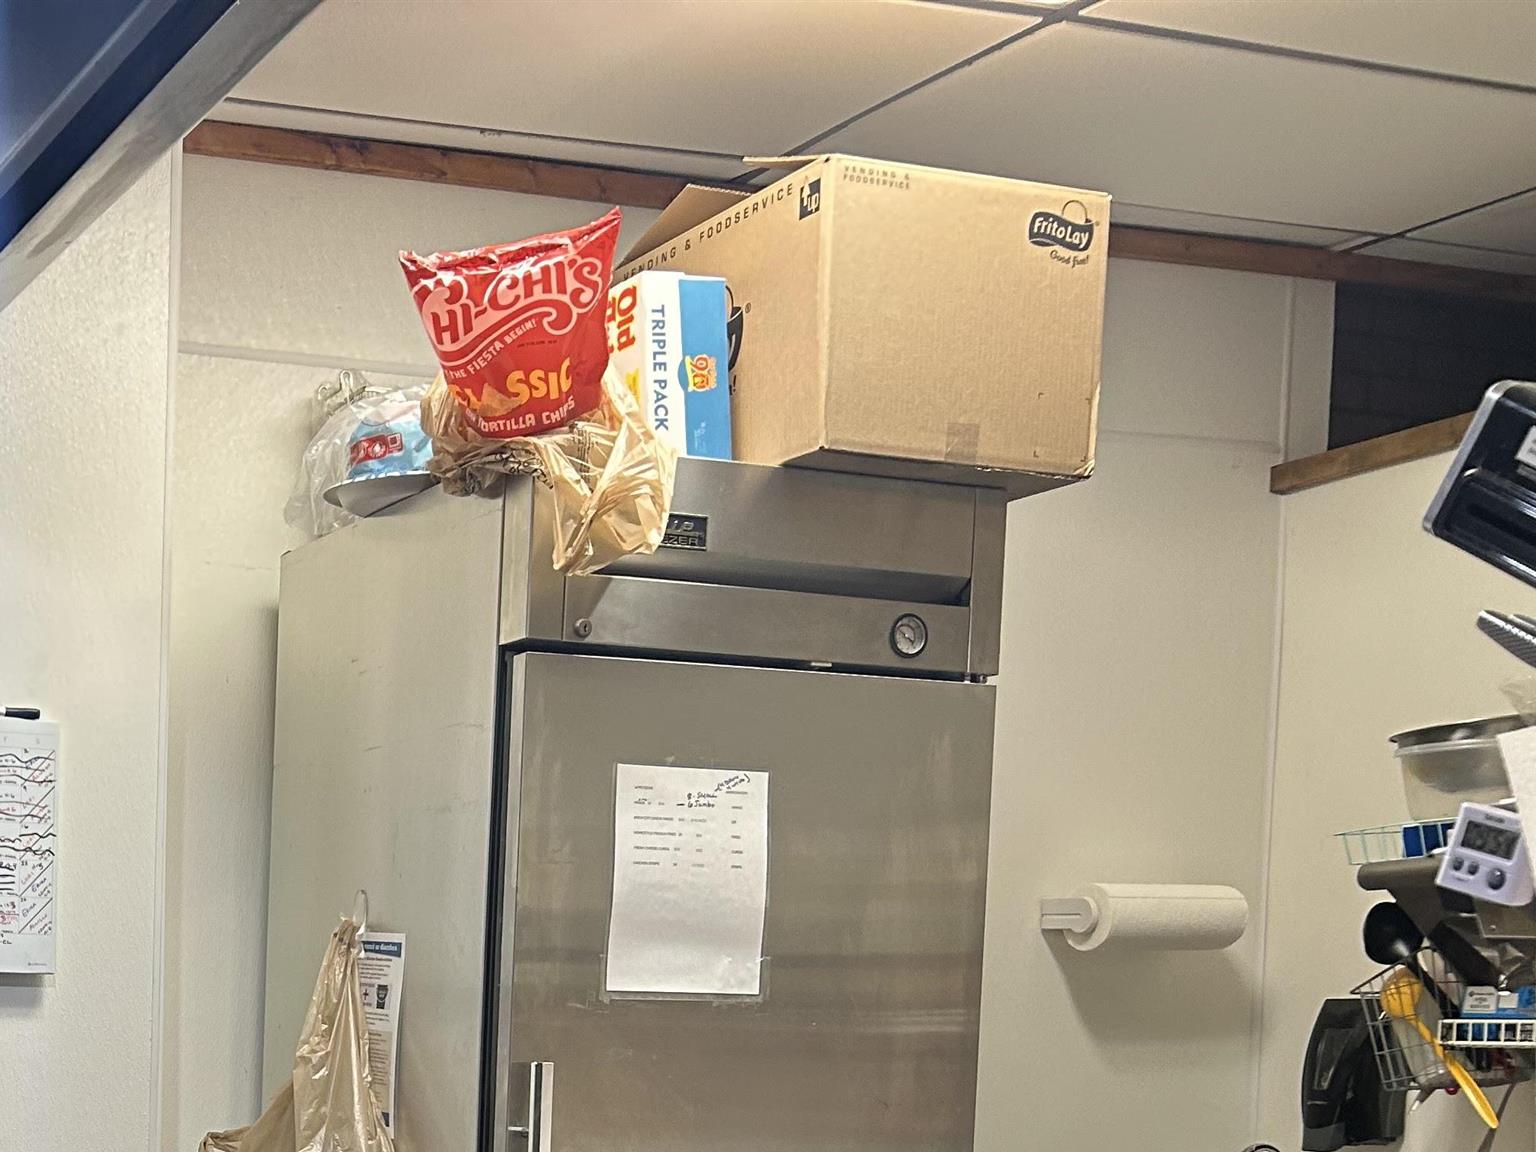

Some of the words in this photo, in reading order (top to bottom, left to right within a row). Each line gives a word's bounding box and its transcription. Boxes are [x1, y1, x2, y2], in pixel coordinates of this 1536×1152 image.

[684, 239, 691, 251] &
[699, 183, 794, 243] FOODSERVICE
[467, 340, 504, 375] FIESTA
[651, 304, 667, 372] TRIPLE
[542, 395, 575, 425] CHIPS
[653, 379, 669, 432] PACK
